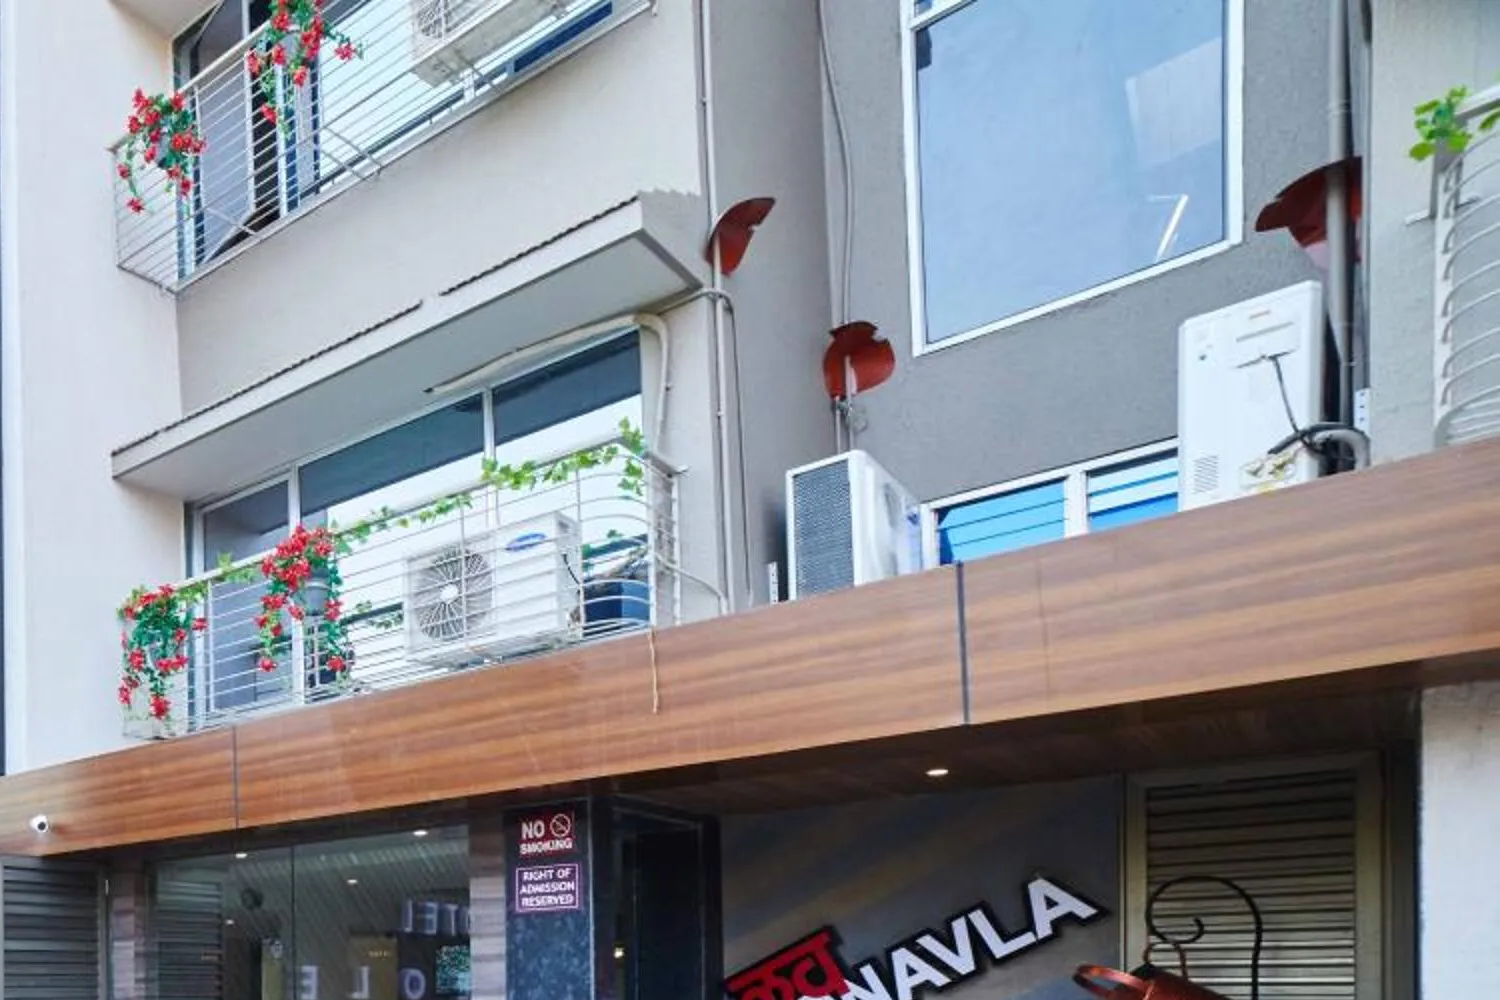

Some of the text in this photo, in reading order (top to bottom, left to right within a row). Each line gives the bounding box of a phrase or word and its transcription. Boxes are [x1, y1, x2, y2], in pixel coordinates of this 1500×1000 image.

[521, 820, 545, 840] NO
[520, 838, 573, 855] SMOKING
[523, 867, 573, 881] RIGHT OF
[520, 880, 575, 895] ADMISSION
[521, 894, 574, 907] RESERVED
